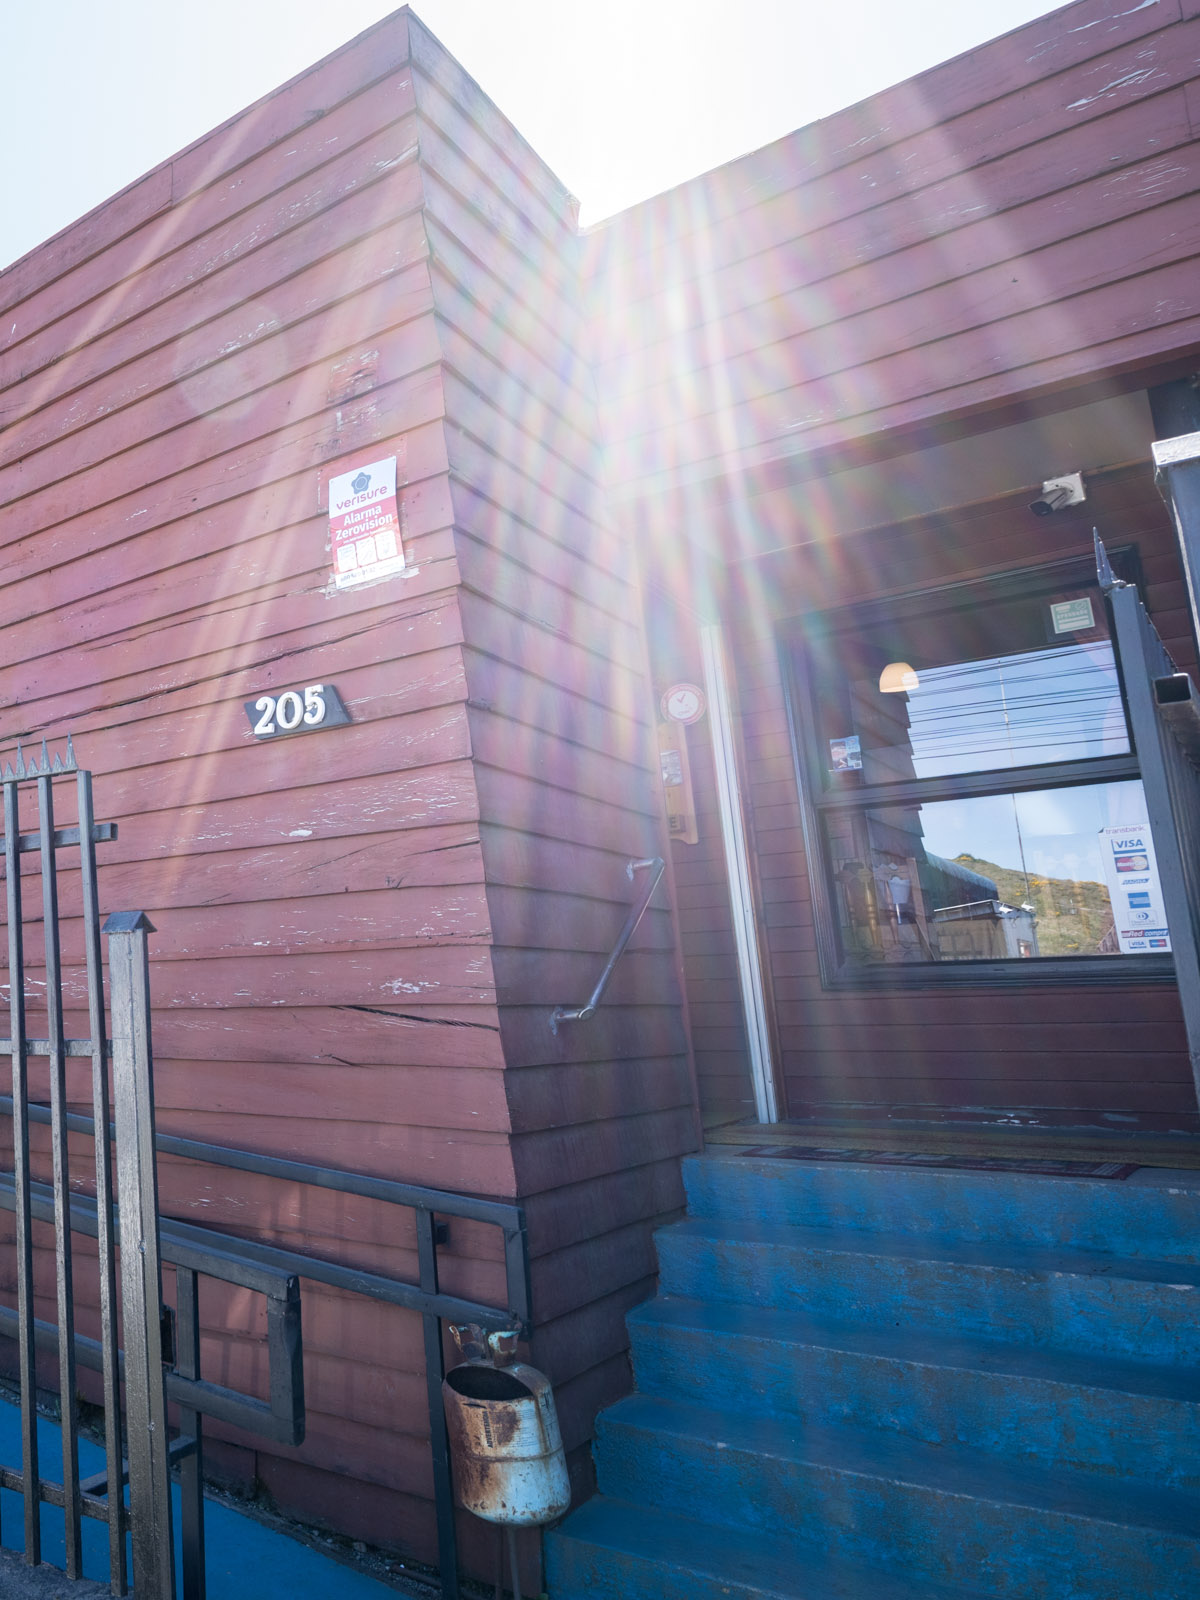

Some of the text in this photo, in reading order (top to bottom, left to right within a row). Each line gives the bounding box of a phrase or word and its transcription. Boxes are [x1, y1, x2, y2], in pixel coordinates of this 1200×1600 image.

[336, 486, 387, 510] verisure
[344, 505, 382, 526] Alarma
[254, 684, 326, 735] 205
[1114, 838, 1143, 849] VISA
